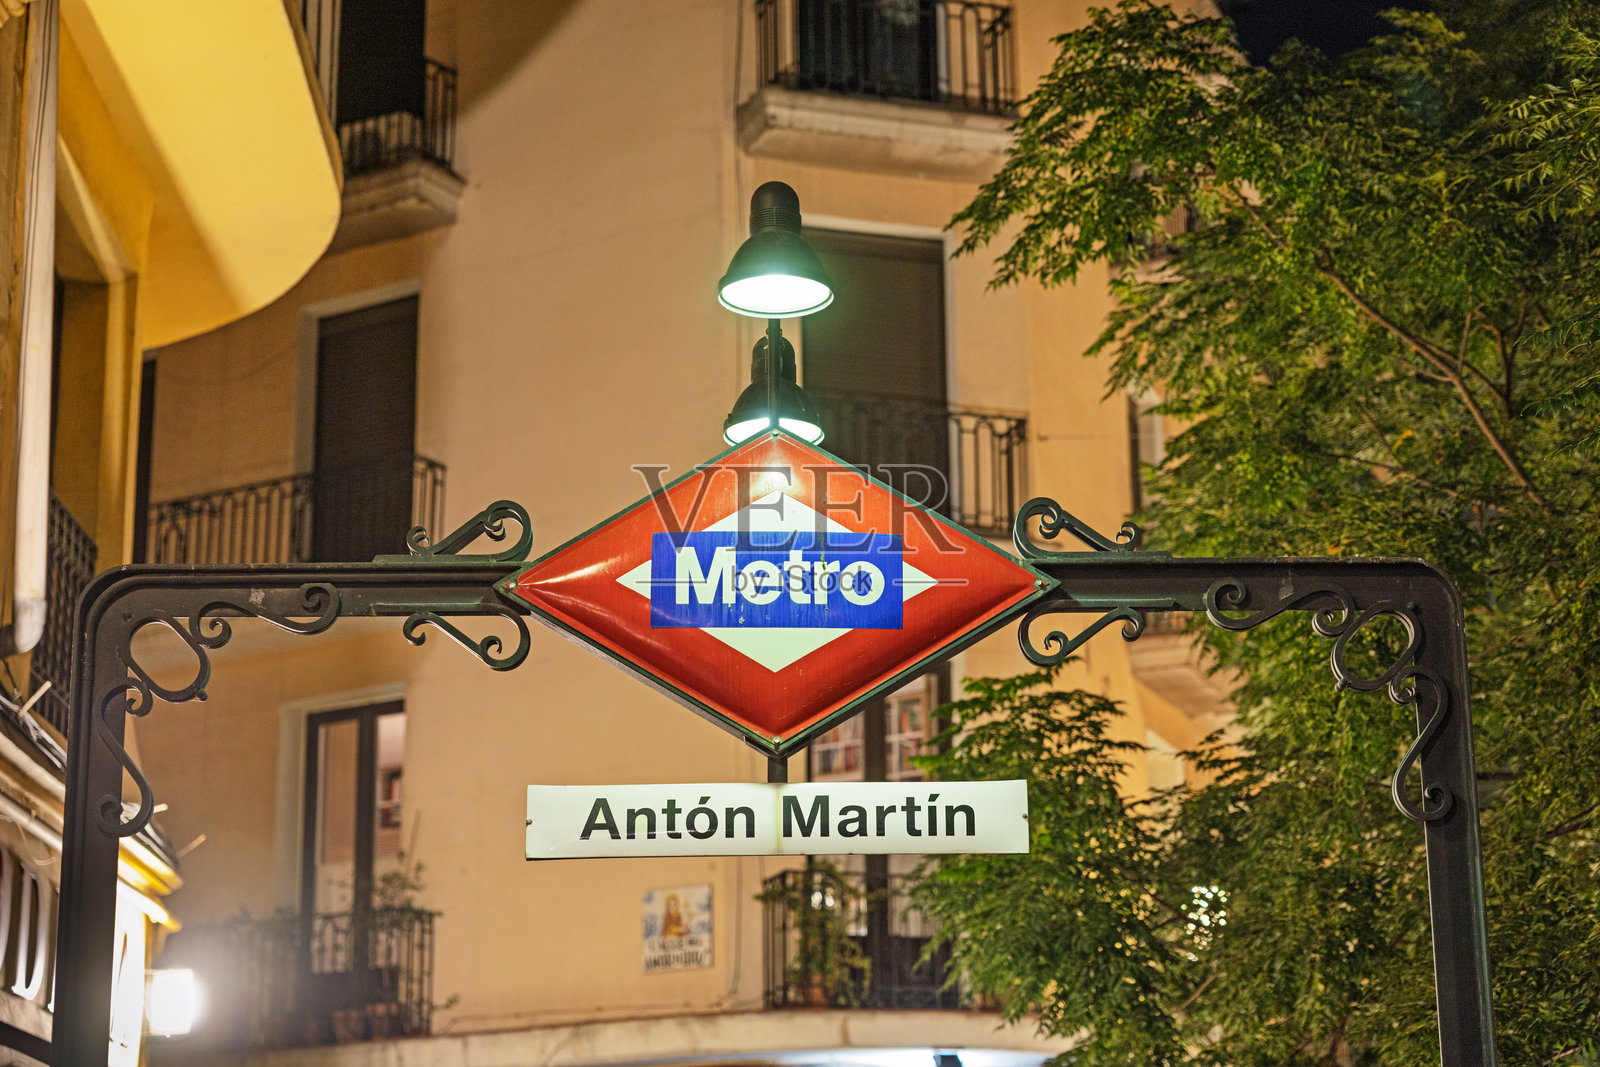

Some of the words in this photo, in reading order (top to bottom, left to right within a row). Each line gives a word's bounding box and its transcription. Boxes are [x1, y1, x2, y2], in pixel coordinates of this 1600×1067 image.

[675, 546, 885, 606] Metro
[579, 796, 756, 840] Antón
[782, 793, 976, 838] Martín
